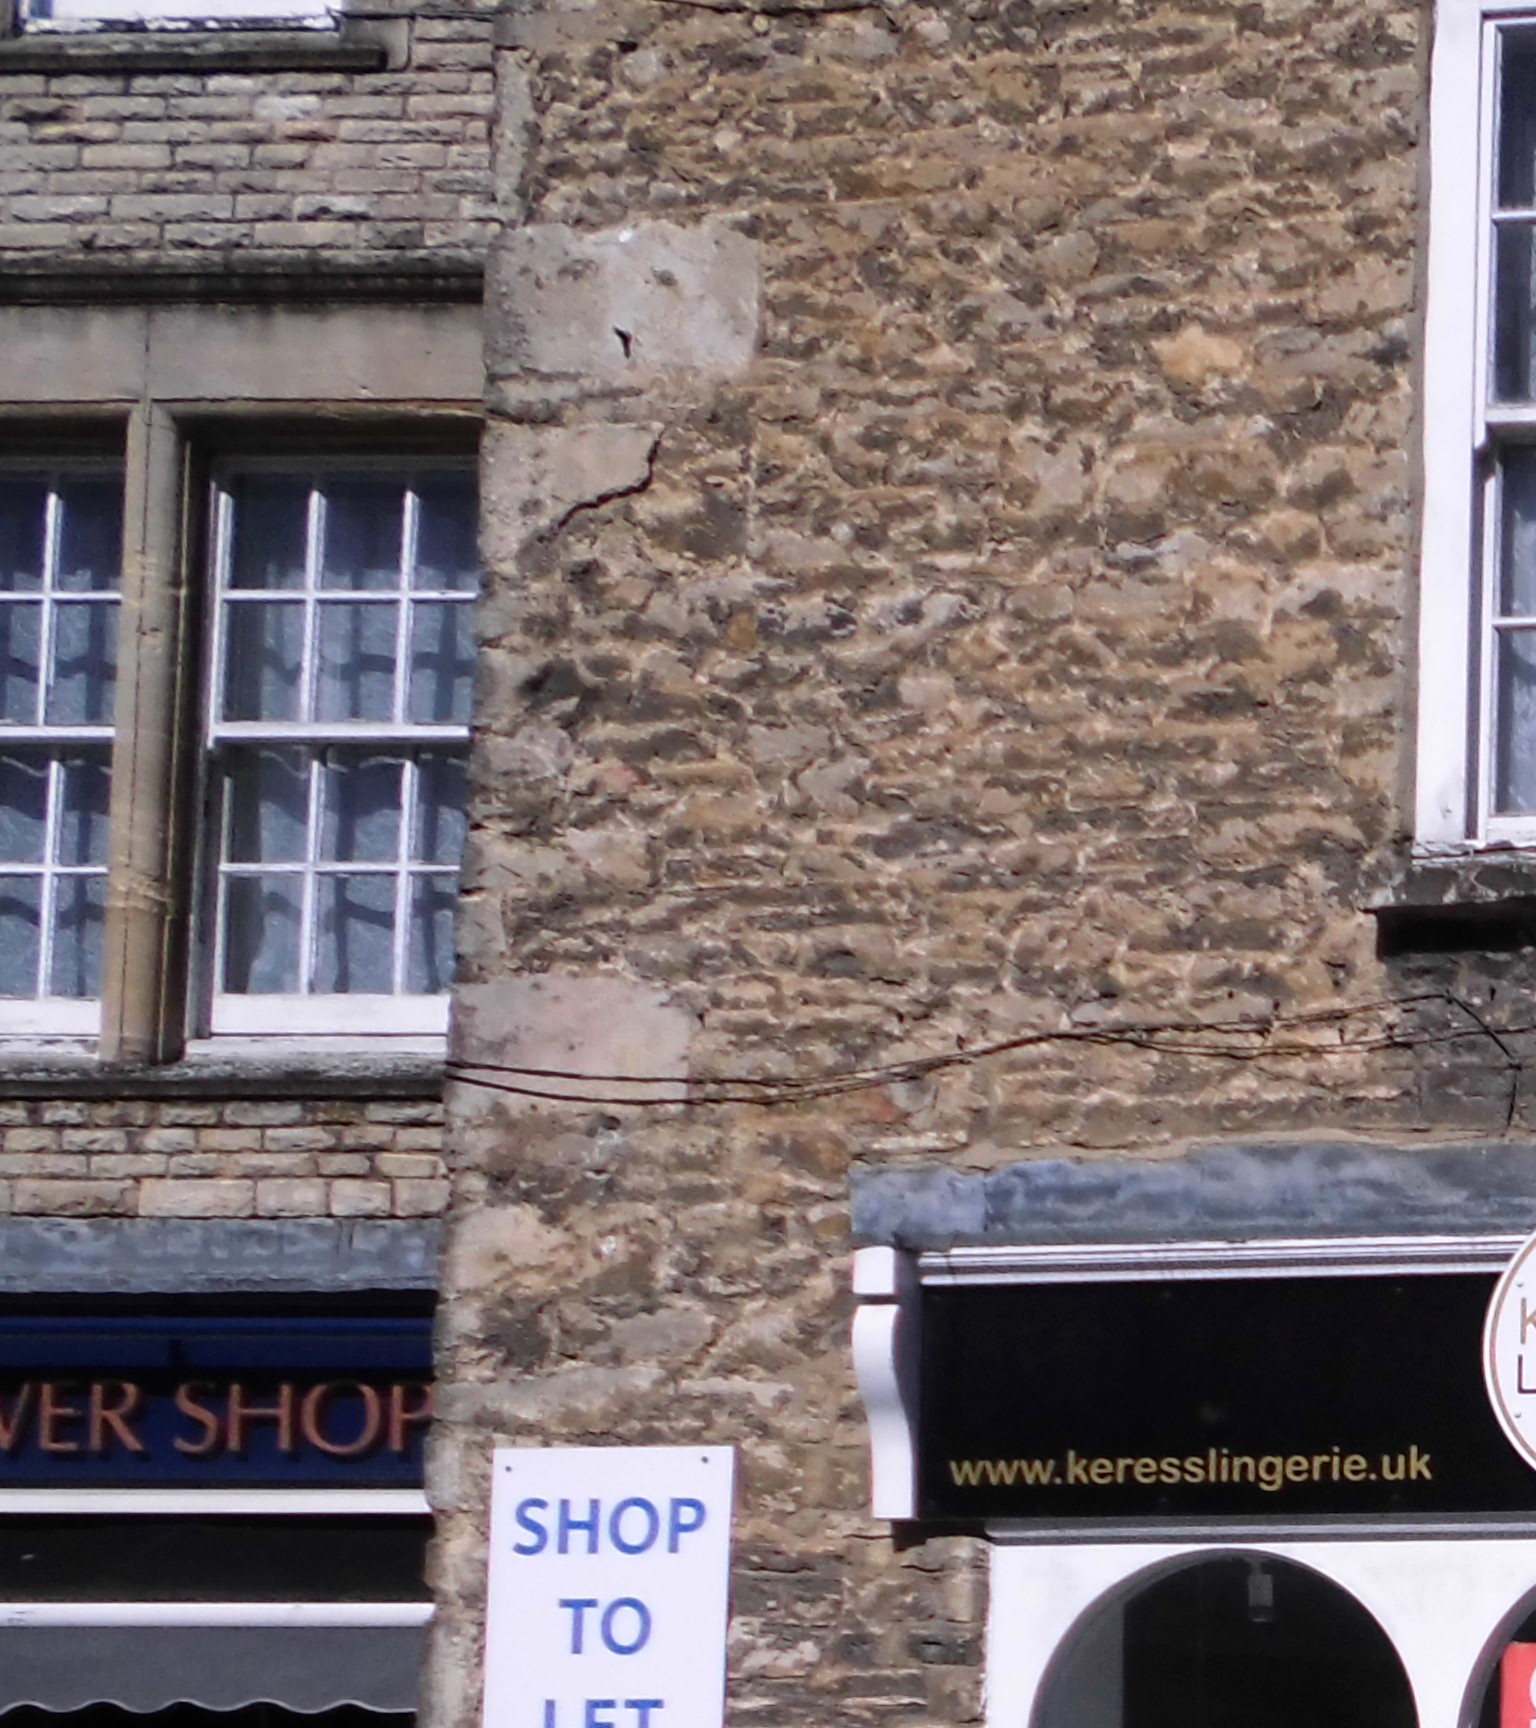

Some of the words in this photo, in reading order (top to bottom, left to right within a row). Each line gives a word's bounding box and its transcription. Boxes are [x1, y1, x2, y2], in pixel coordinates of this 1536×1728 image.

[172, 1380, 434, 1455] SHOP
[949, 1444, 1434, 1491] www.keresslingerie.uk
[512, 1497, 706, 1556] SHOP
[558, 1597, 653, 1655] TO
